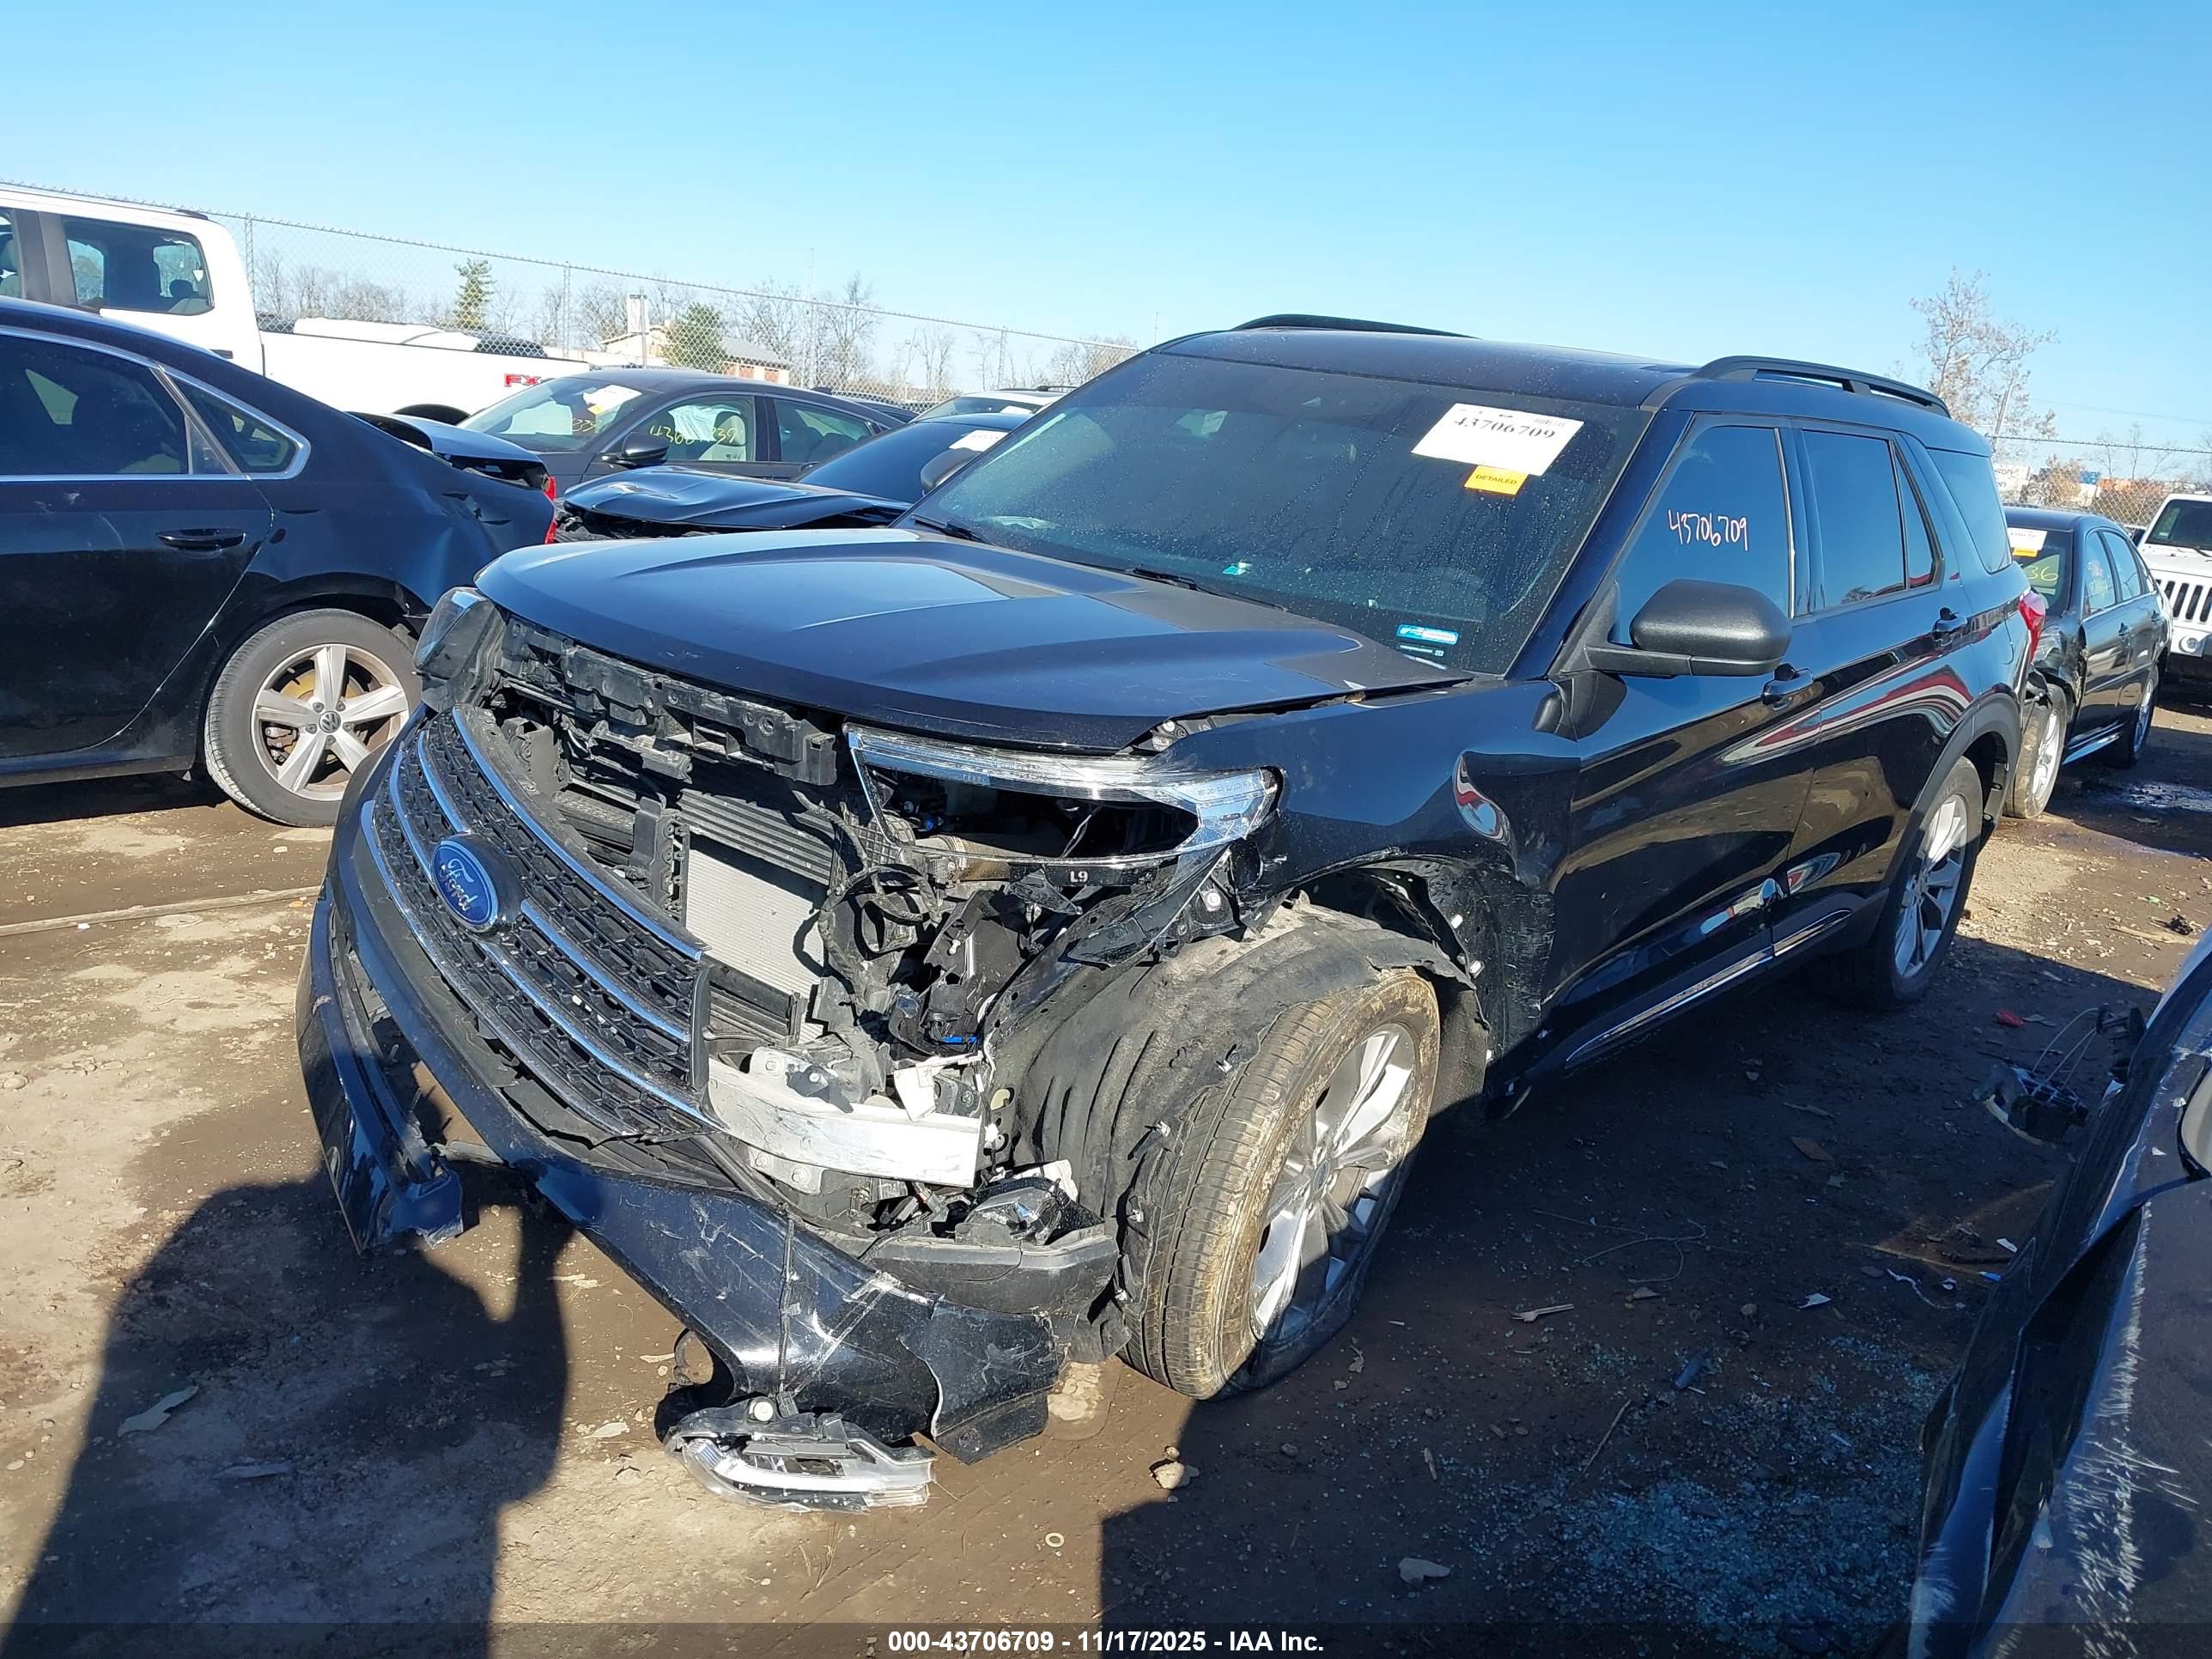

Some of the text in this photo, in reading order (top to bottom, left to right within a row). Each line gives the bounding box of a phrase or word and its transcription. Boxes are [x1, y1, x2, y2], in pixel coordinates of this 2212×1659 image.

[1454, 416, 1556, 439] 43706709
[1475, 474, 1518, 486] DETAILED
[1668, 508, 1749, 552] 43706709
[439, 858, 478, 911] Ford
[1070, 871, 1089, 883] L9
